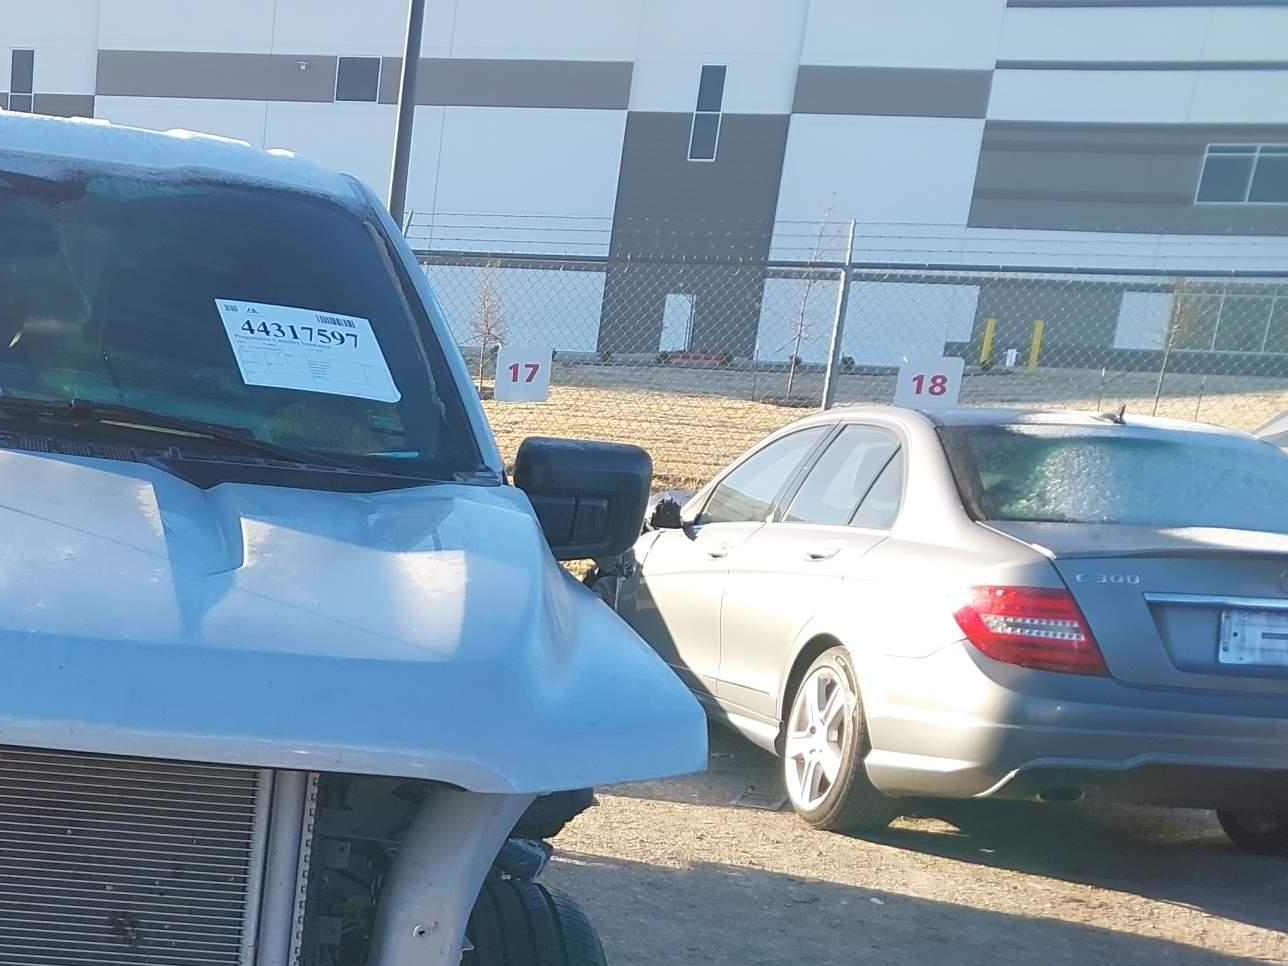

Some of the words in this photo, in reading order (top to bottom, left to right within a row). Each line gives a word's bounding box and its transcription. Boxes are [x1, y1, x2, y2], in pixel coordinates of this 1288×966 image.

[241, 319, 359, 349] 44317597
[509, 363, 540, 382] 17
[912, 374, 948, 396] 18
[1075, 573, 1089, 583] C
[1095, 573, 1140, 585] 300
